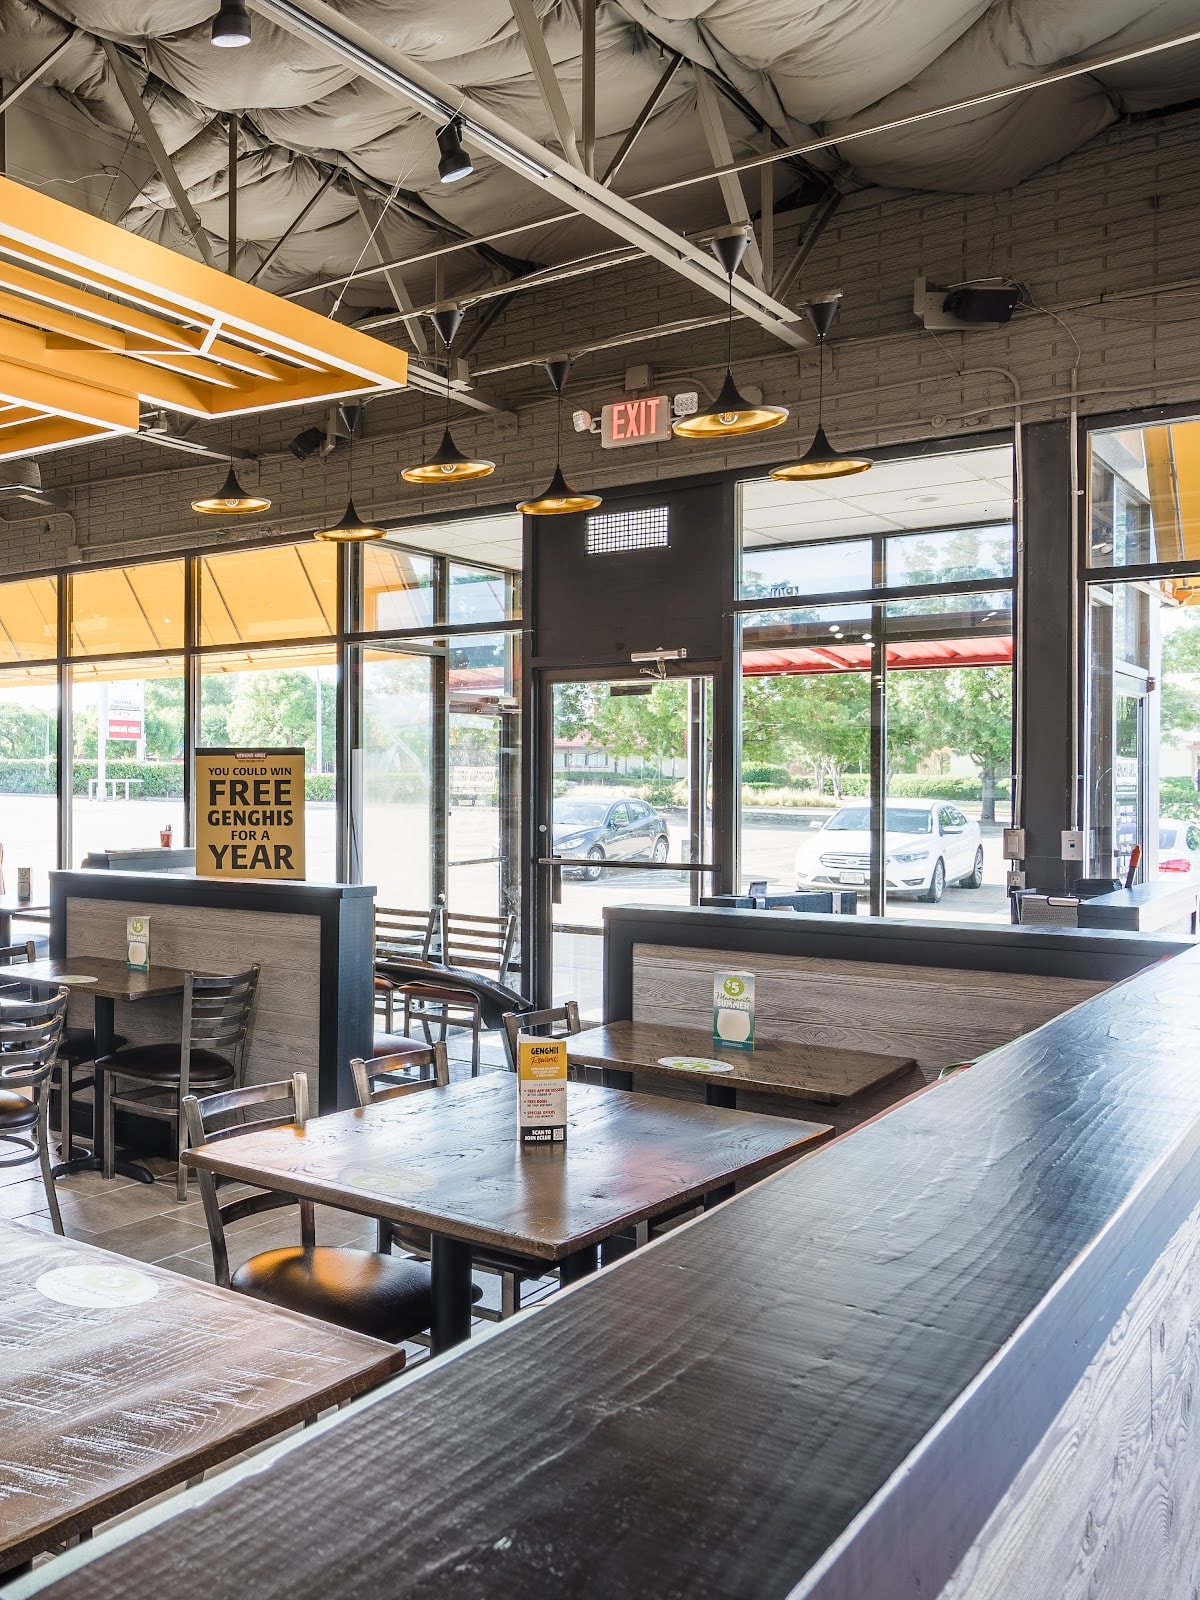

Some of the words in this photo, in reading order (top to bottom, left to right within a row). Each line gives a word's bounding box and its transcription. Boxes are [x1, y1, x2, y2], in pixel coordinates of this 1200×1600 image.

[612, 399, 660, 440] EXIT
[208, 768, 229, 776] YOU
[233, 768, 267, 776] COULD
[270, 768, 292, 776] WIN
[209, 779, 292, 806] FREE
[207, 810, 294, 826] GENGHIS
[231, 830, 256, 841] FOR
[261, 830, 270, 841] A
[208, 844, 294, 870] YEAR
[726, 980, 740, 994] $5
[717, 1000, 750, 1010] SUMMER
[531, 1046, 559, 1055] GENGHIS
